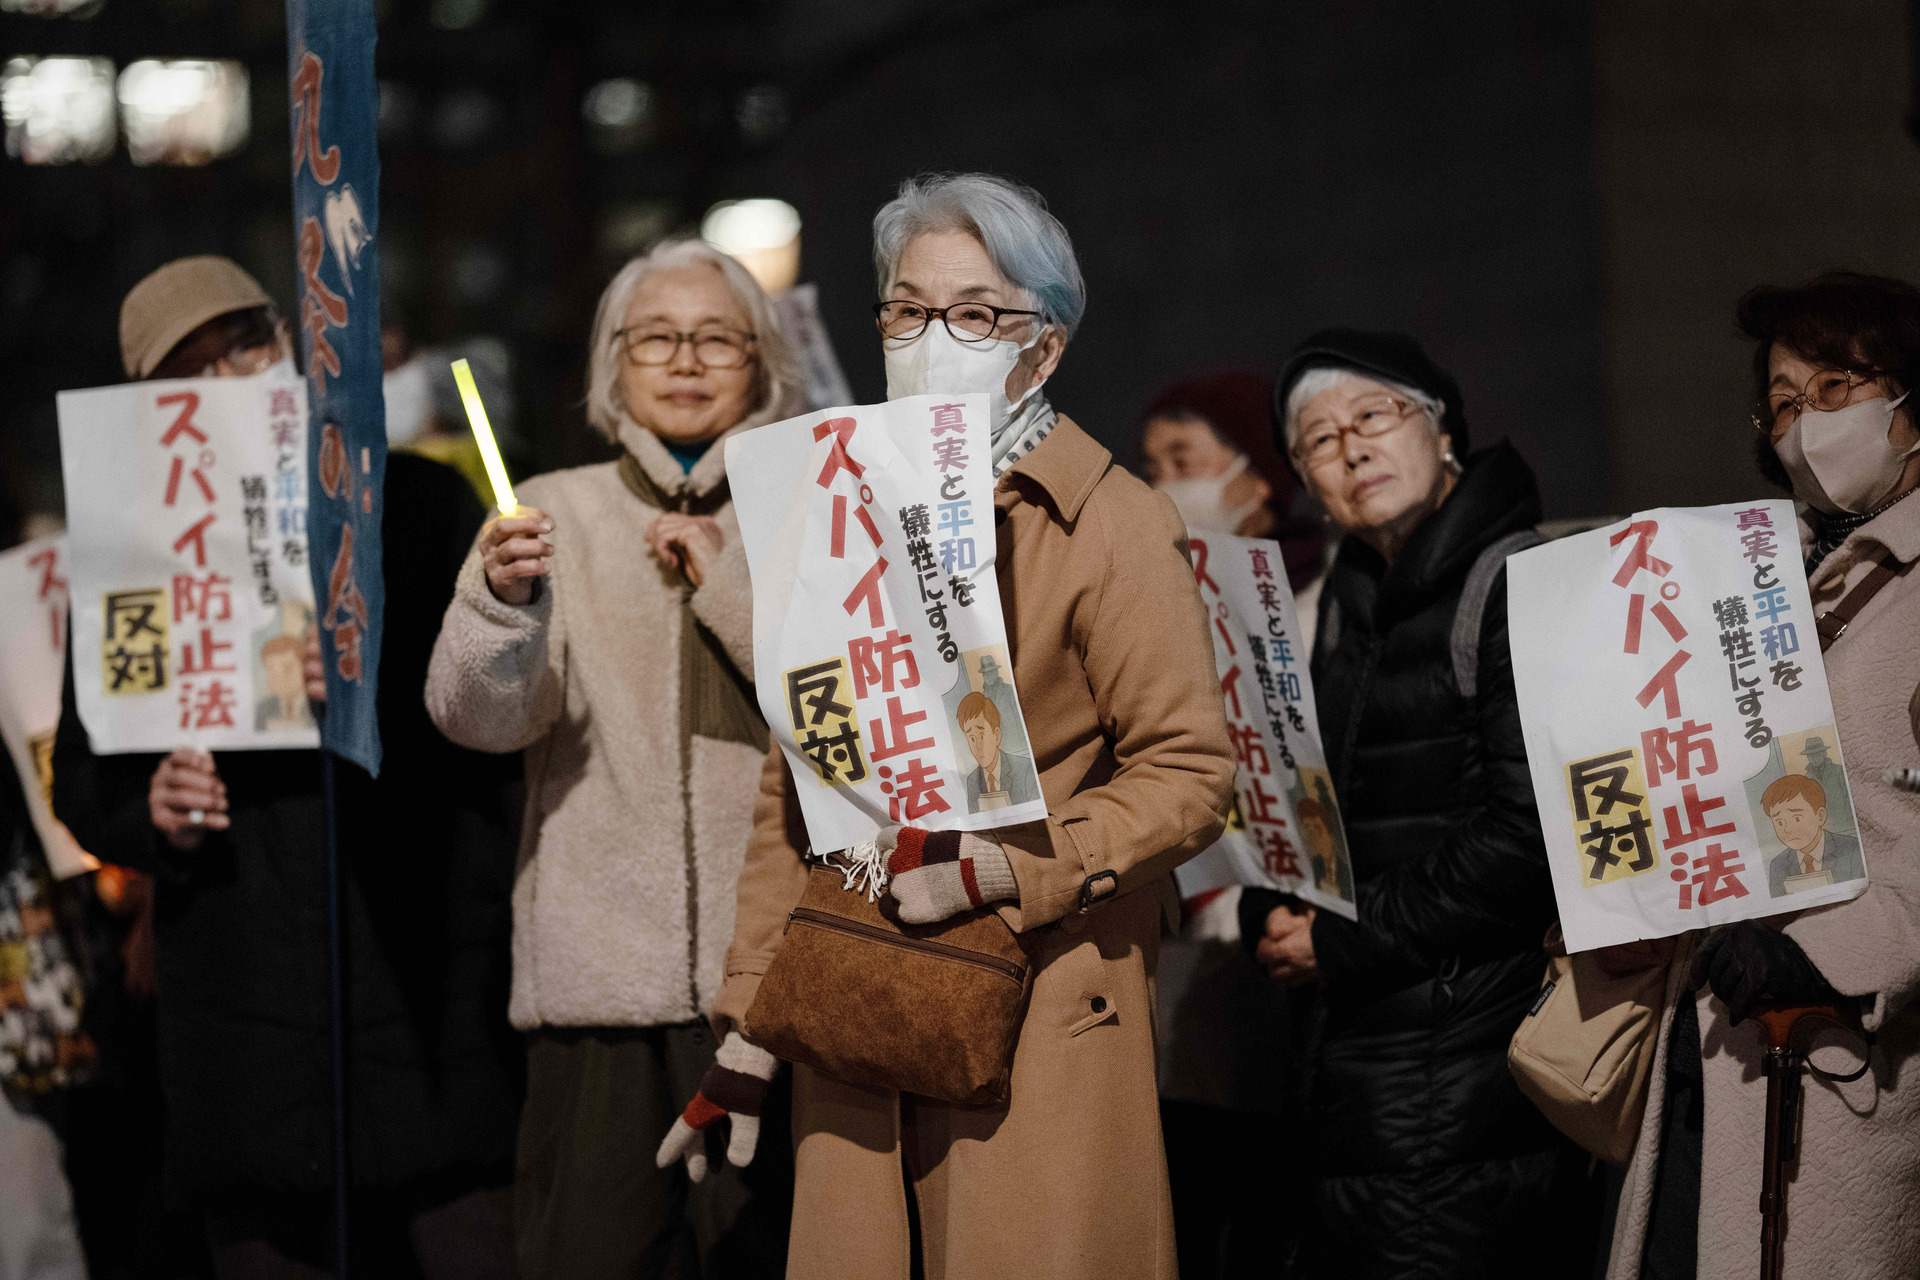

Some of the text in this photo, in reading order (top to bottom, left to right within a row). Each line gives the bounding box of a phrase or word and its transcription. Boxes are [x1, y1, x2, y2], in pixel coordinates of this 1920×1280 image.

[156, 390, 238, 729] スパイ防止法
[900, 503, 958, 663] 犠牲にする
[929, 403, 977, 608] 真実と平和を
[105, 589, 169, 691] 反対
[812, 416, 951, 822] スパイ防止法
[1248, 548, 1304, 733] 真実と平和を
[1712, 595, 1772, 749] 犠牲にする
[1734, 506, 1803, 692] 真実と平和を
[787, 659, 865, 783] 反対
[1609, 519, 1750, 910] スパイ防止法
[1569, 749, 1655, 881] 反対
